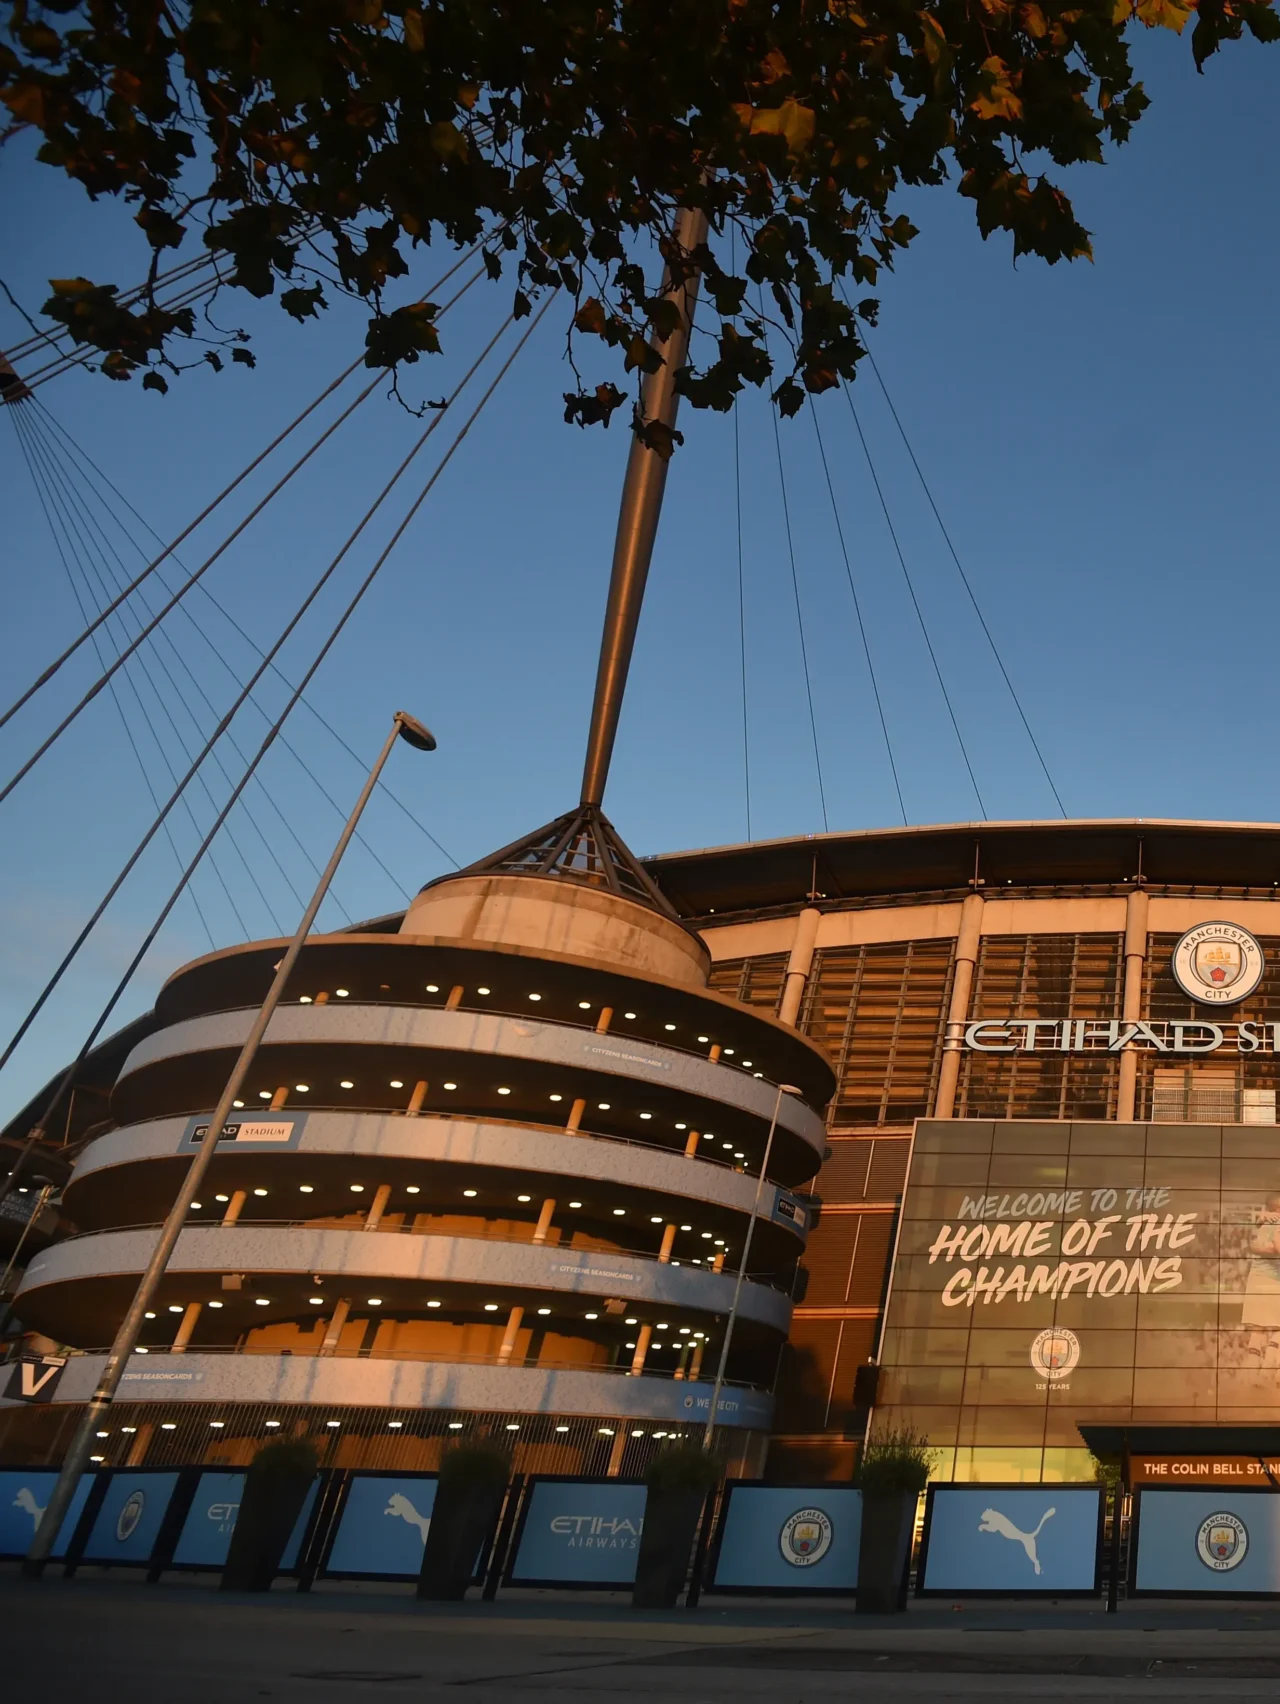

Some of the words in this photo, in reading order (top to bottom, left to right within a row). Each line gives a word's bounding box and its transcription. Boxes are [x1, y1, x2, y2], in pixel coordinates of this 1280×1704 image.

[1183, 927, 1255, 953] MANCHESTER
[1205, 990, 1232, 999] CITY
[964, 1019, 1224, 1052] ETIHAD
[244, 1127, 286, 1136] STADIUM
[958, 1190, 1083, 1220] WELCOME
[1090, 1188, 1117, 1212] TO
[1125, 1186, 1172, 1210] THE
[929, 1221, 1055, 1264] HOME
[1062, 1214, 1122, 1256] OF
[1126, 1212, 1198, 1254] THE
[941, 1255, 1183, 1307] CHAMPIONS
[1035, 1329, 1077, 1346] MANCHESTER
[21, 1363, 60, 1396] V
[696, 1398, 710, 1408] WE
[725, 1401, 740, 1411] CITY
[1144, 1463, 1168, 1475] THE
[1171, 1463, 1209, 1475] COLIN
[1213, 1463, 1243, 1475] BELL
[787, 1511, 830, 1530] MANCHESTER
[1202, 1516, 1244, 1534] MANCHESTER
[568, 1537, 637, 1549] AIRWAYS
